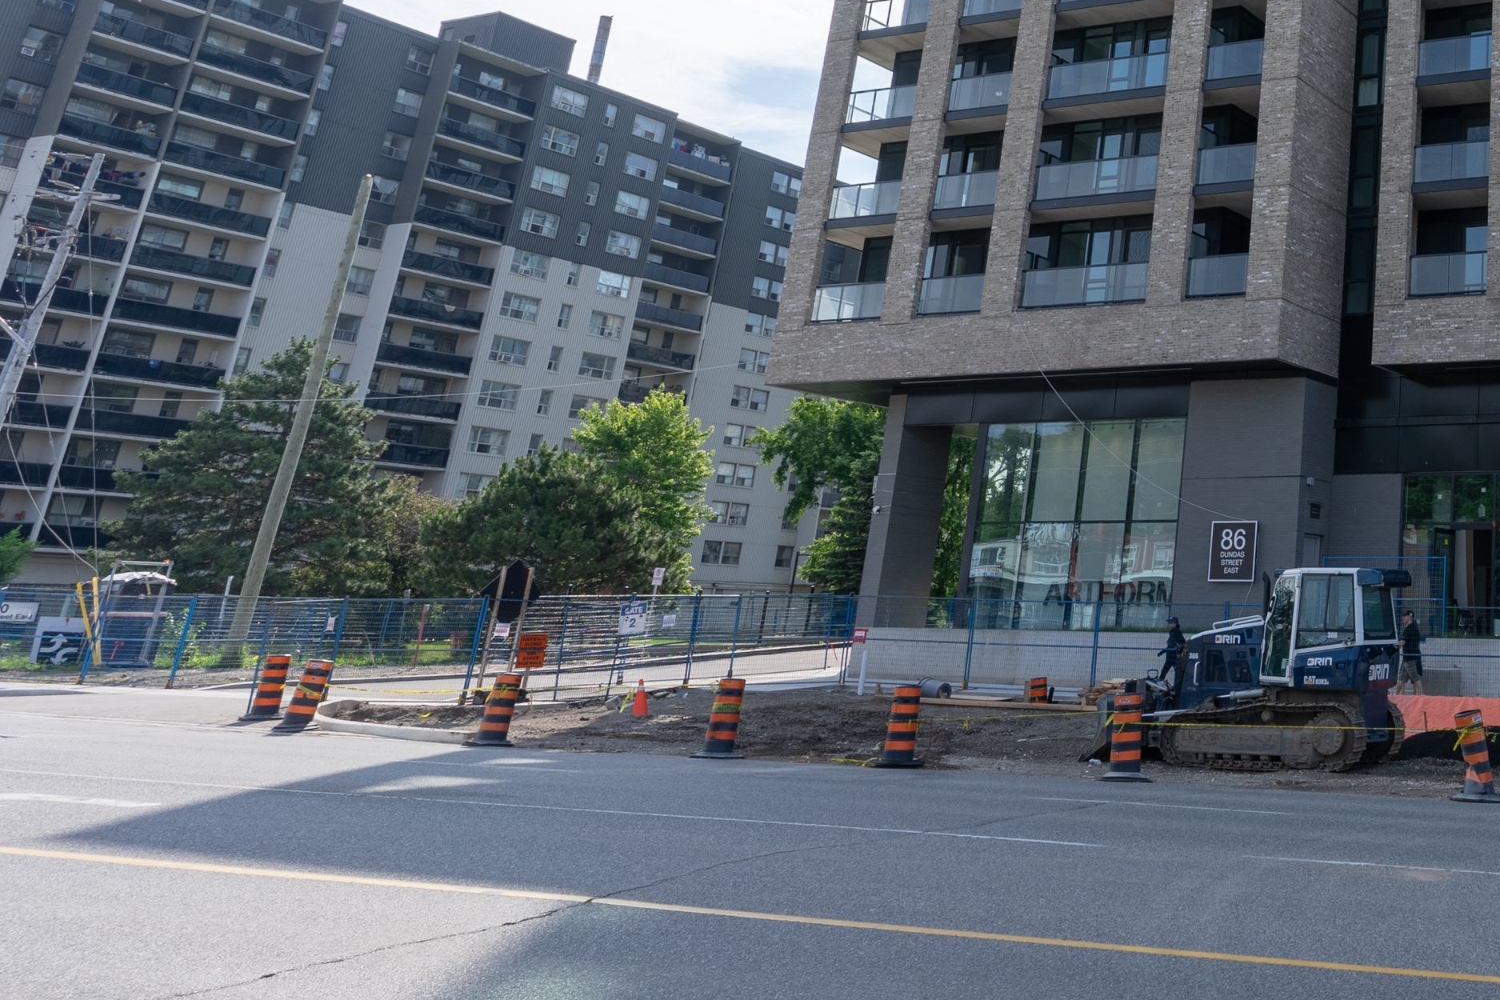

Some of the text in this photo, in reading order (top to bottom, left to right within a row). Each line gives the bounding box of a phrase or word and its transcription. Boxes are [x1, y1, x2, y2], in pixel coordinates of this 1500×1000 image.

[1220, 528, 1246, 550] 86
[624, 606, 644, 615] GATE
[629, 617, 636, 628] 2
[1303, 675, 1317, 685] CAT
